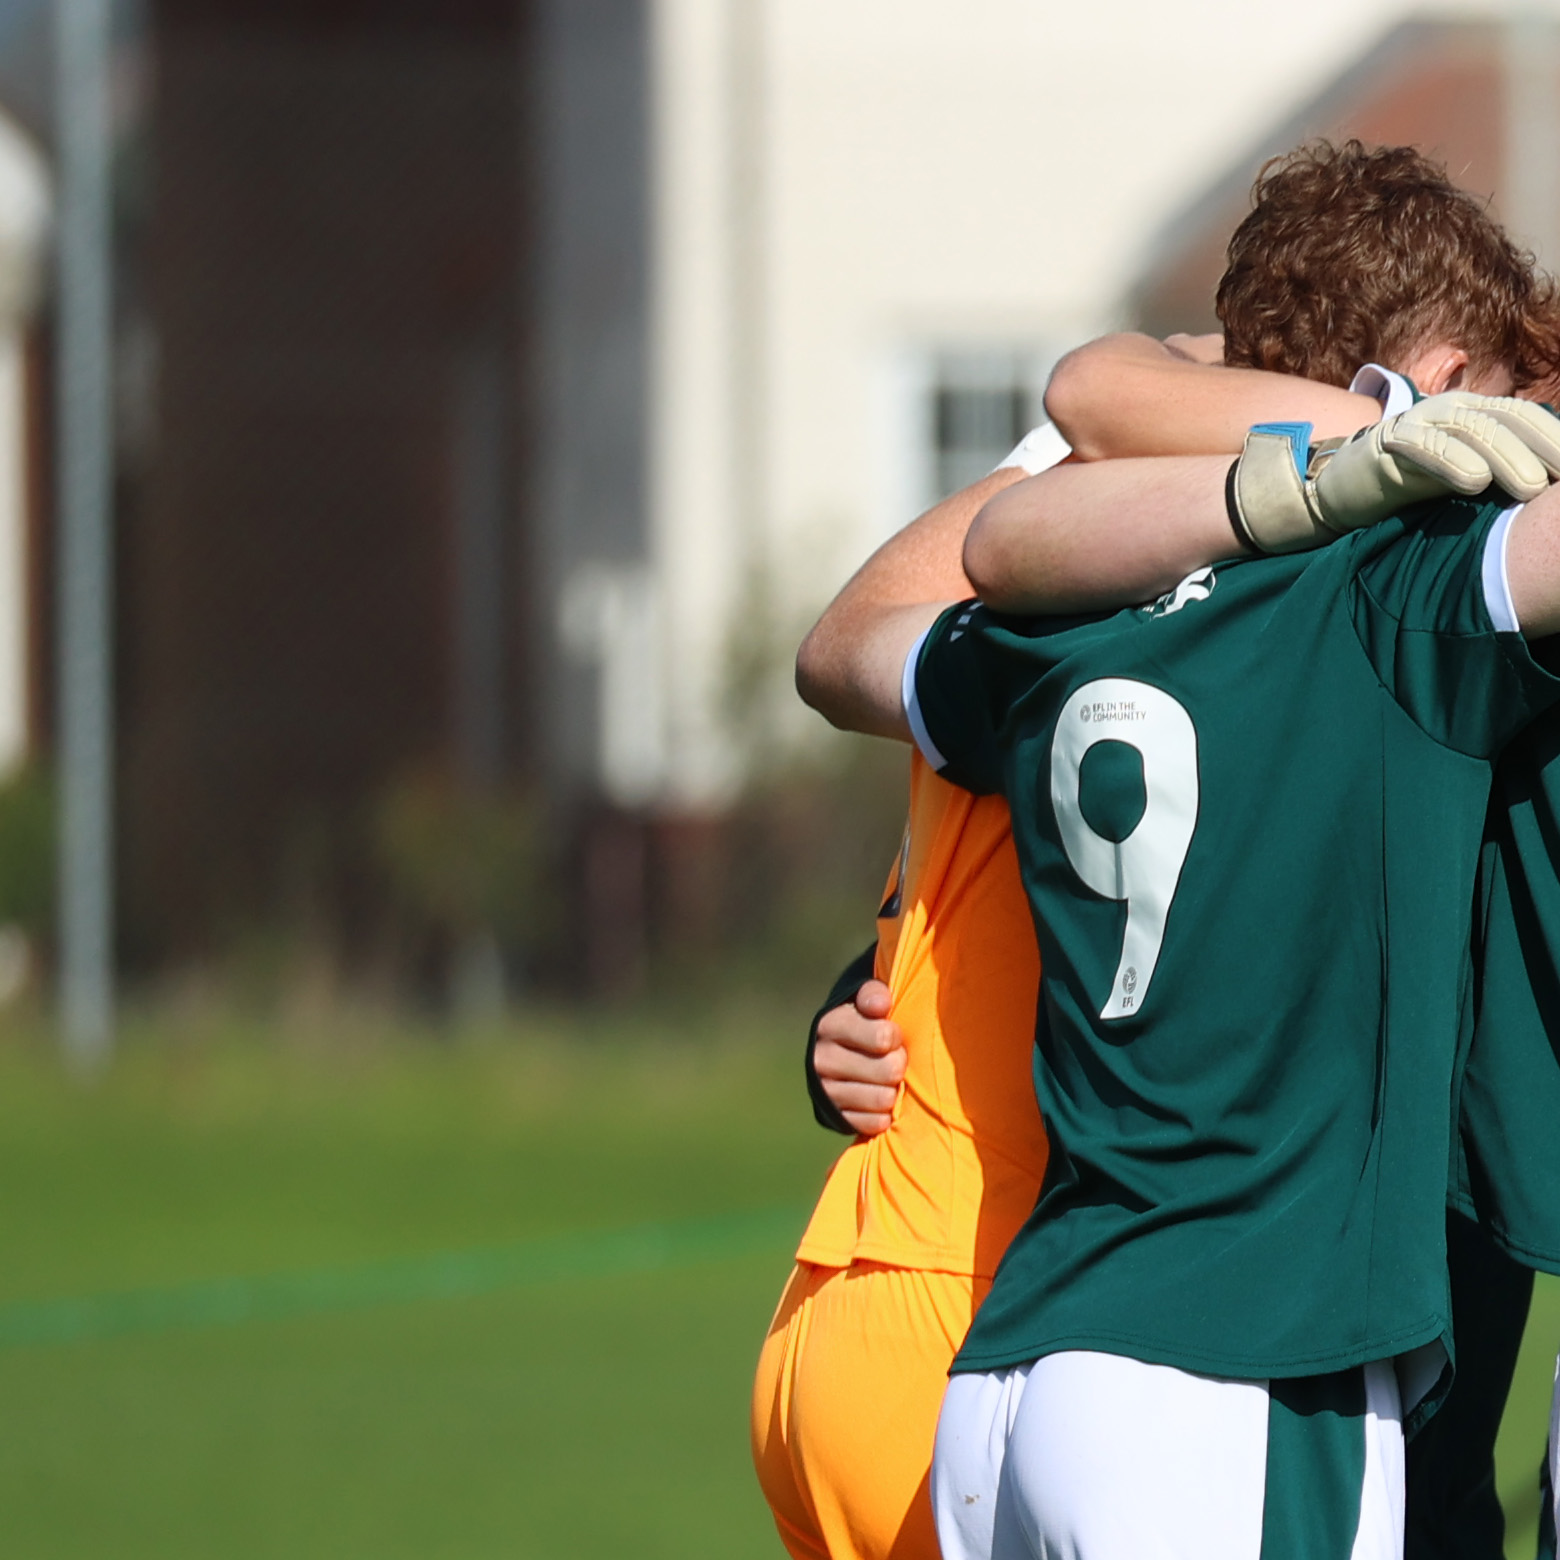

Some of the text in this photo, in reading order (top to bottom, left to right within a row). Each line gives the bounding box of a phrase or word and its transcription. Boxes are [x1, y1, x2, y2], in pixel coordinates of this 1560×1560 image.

[1092, 701, 1136, 712] EFL IN THE
[1093, 711, 1147, 722] COMMUNITY
[1051, 676, 1201, 1021] 9
[1122, 996, 1134, 1008] EFL
